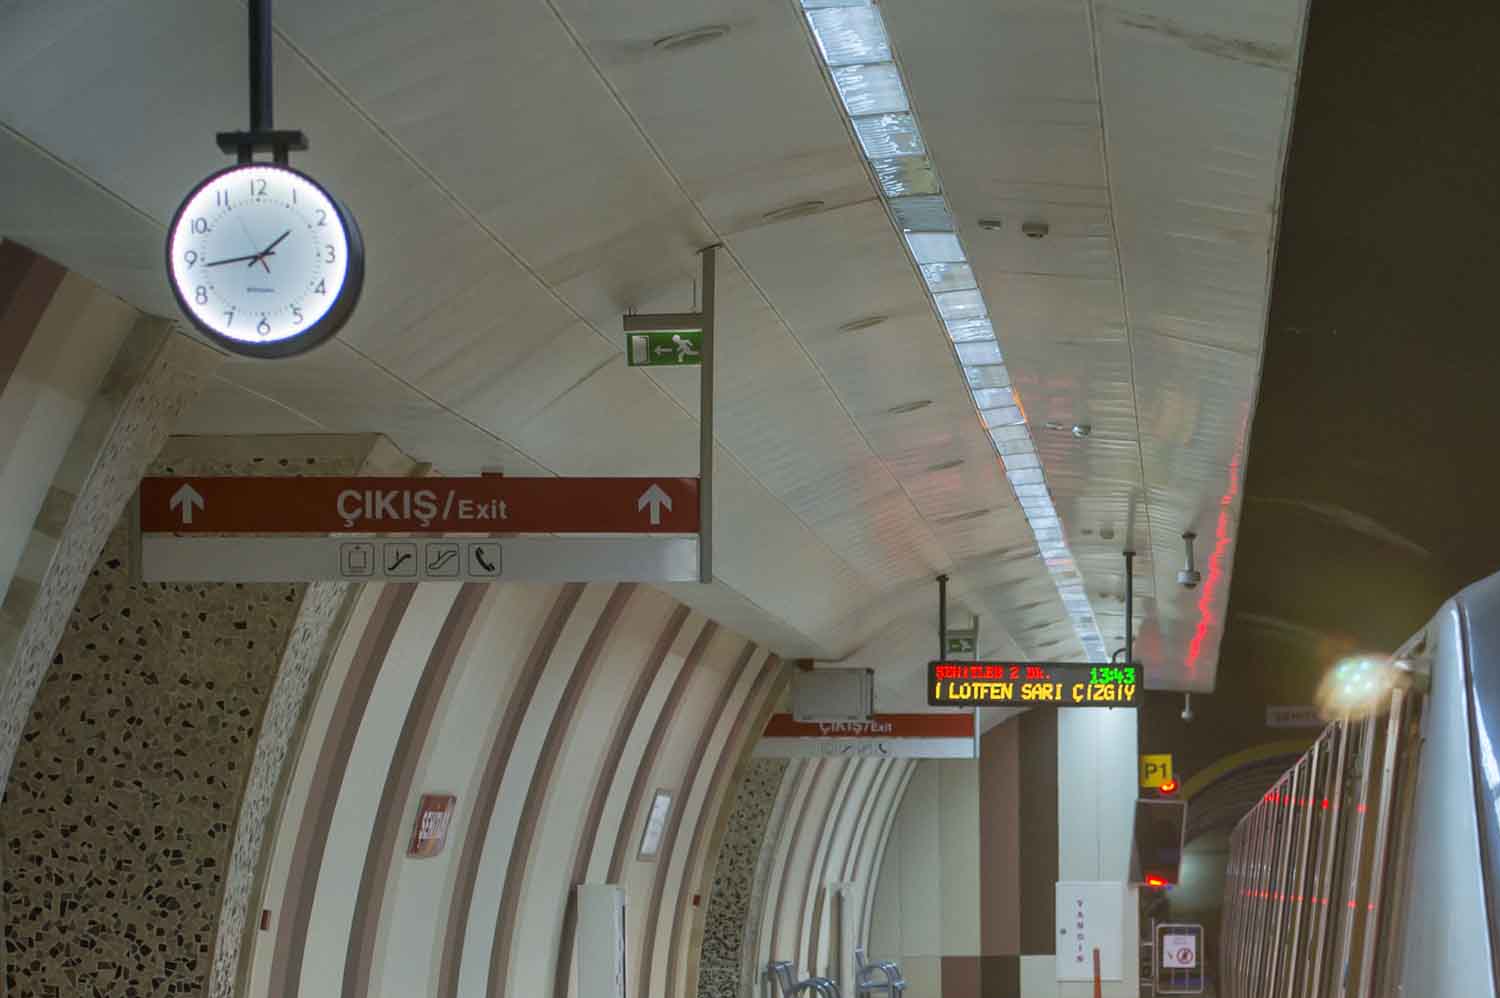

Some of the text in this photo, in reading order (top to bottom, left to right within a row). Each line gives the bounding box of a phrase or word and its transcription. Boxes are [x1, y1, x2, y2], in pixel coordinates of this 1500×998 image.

[249, 178, 267, 197] 12
[292, 188, 297, 204] 1
[217, 190, 230, 207] 11
[190, 217, 208, 235] 10
[316, 209, 328, 226] 2
[184, 250, 198, 269] 9
[325, 245, 336, 264] 3
[195, 286, 208, 305] 8
[314, 279, 327, 295] 4
[223, 312, 235, 328] 7
[293, 307, 304, 325] 5
[257, 318, 271, 336] 6
[1009, 666, 1020, 680] 2
[1089, 667, 1136, 685] 13:43
[1021, 682, 1063, 700] SARI
[1144, 763, 1168, 779] P1
